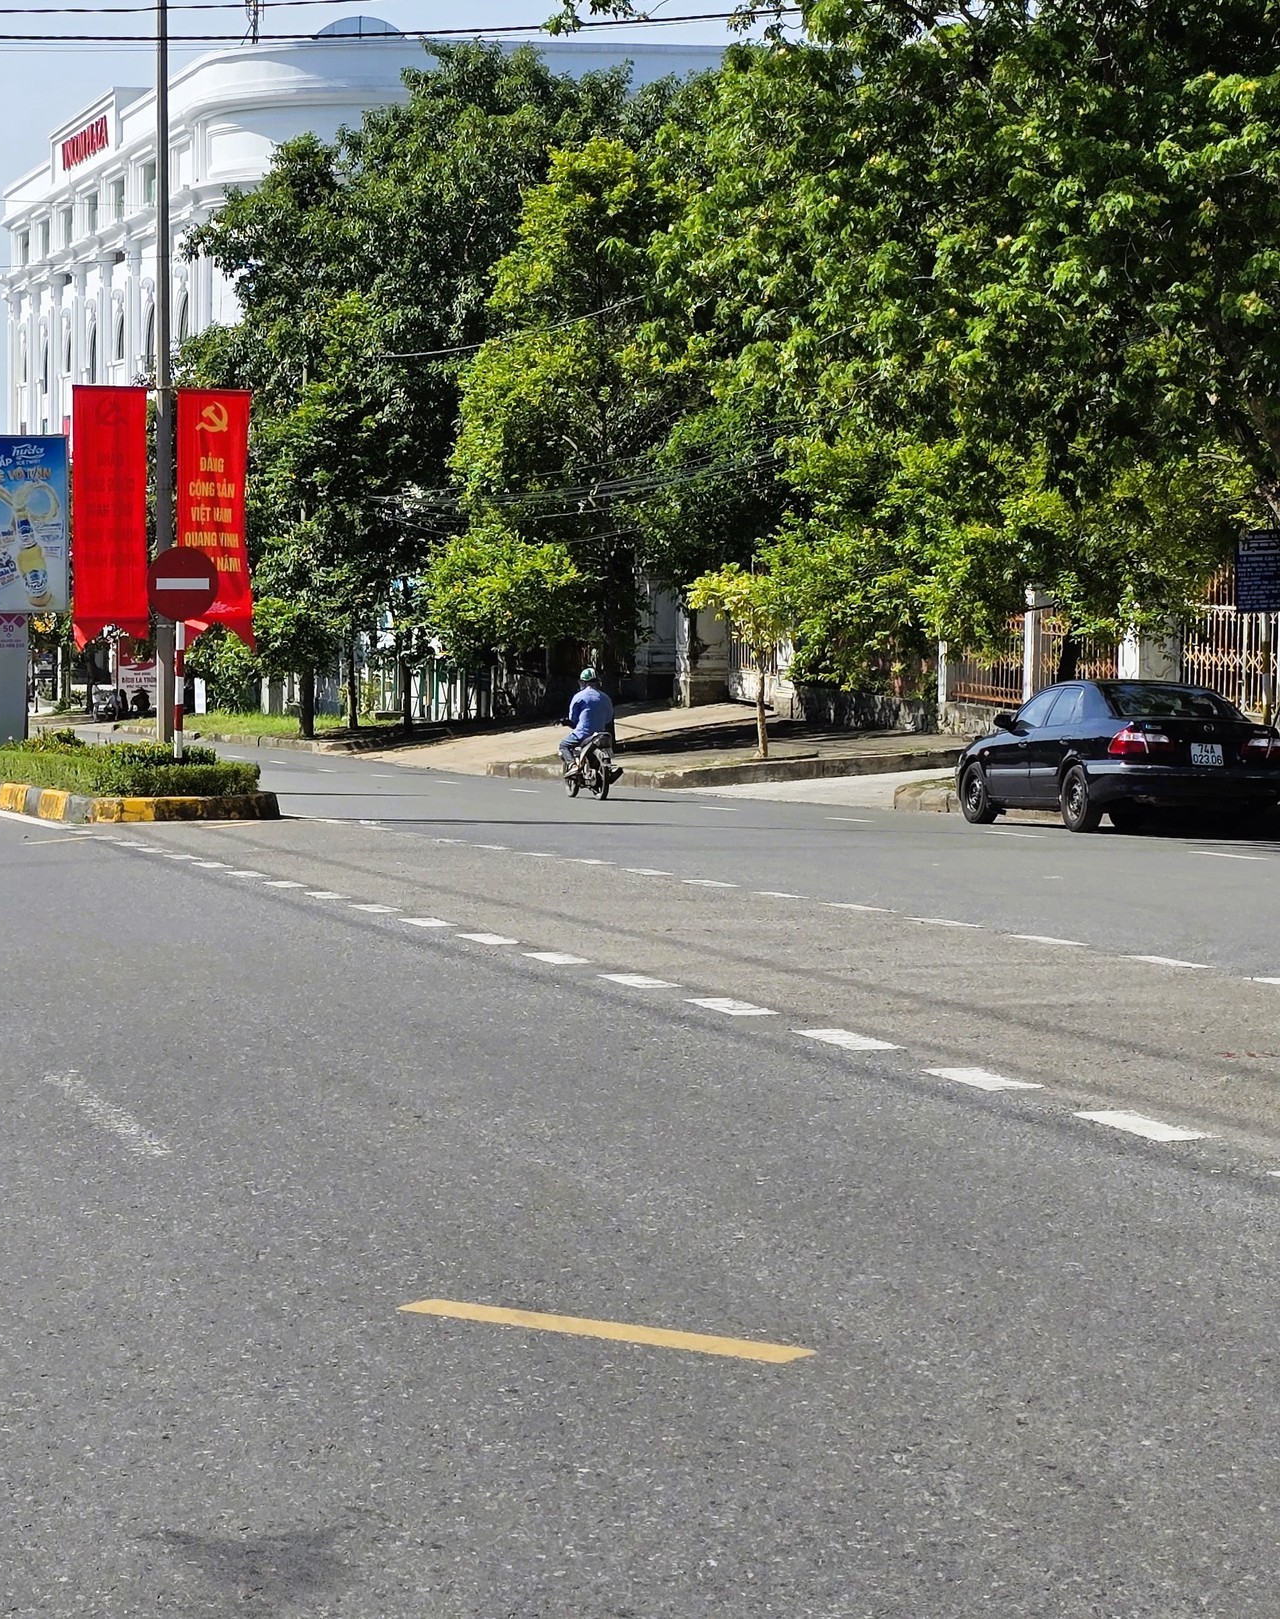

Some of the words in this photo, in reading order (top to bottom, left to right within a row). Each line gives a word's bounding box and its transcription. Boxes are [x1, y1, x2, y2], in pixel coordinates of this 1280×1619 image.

[12, 444, 45, 458] Huda
[200, 452, 224, 473] ĐẢNG
[189, 479, 215, 500] CỘNG
[217, 478, 235, 498] SẢN
[191, 503, 211, 525] VIỆT
[214, 507, 232, 523] NAM
[185, 531, 217, 547] QUANG
[219, 532, 239, 548] VINH
[1198, 744, 1215, 754] 74A
[1193, 755, 1223, 765] 023.06
